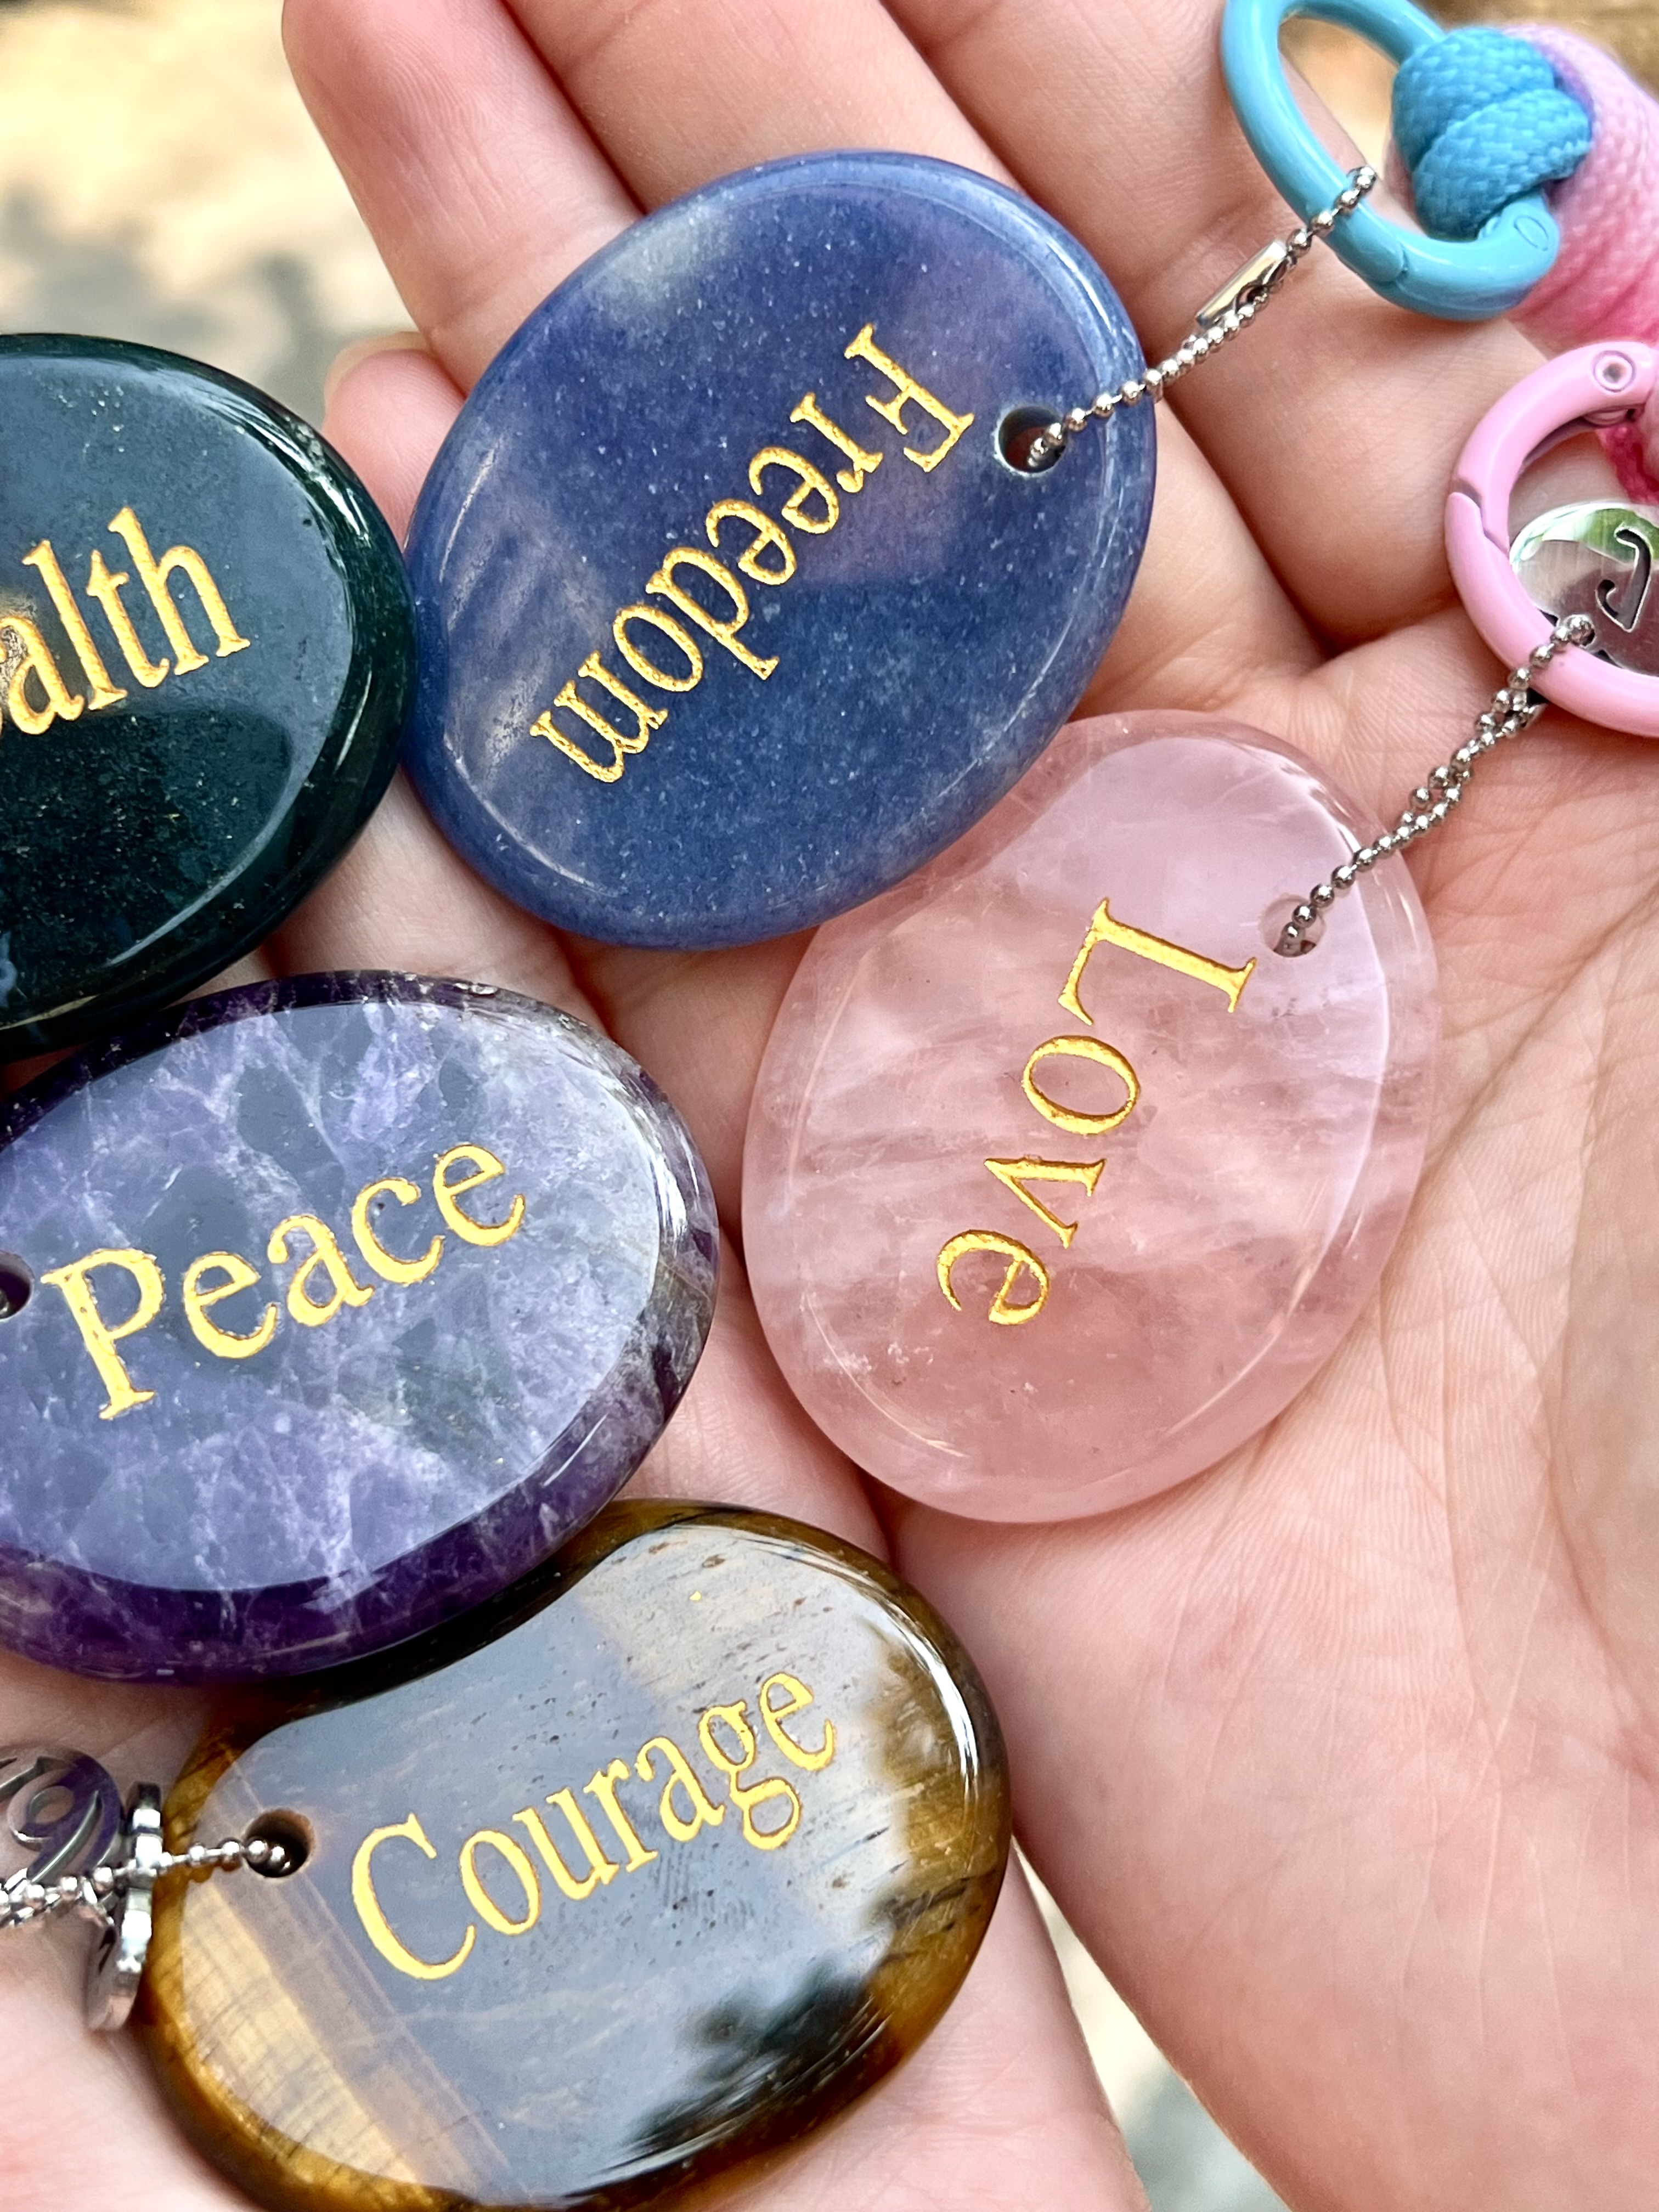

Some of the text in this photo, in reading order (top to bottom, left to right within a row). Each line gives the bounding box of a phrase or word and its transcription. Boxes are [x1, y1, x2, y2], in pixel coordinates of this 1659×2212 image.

[0, 507, 250, 735] alth
[531, 324, 975, 783] Freedom
[937, 898, 1256, 1325] Love
[41, 1144, 525, 1420] Peace
[352, 1672, 836, 1980] Courage
